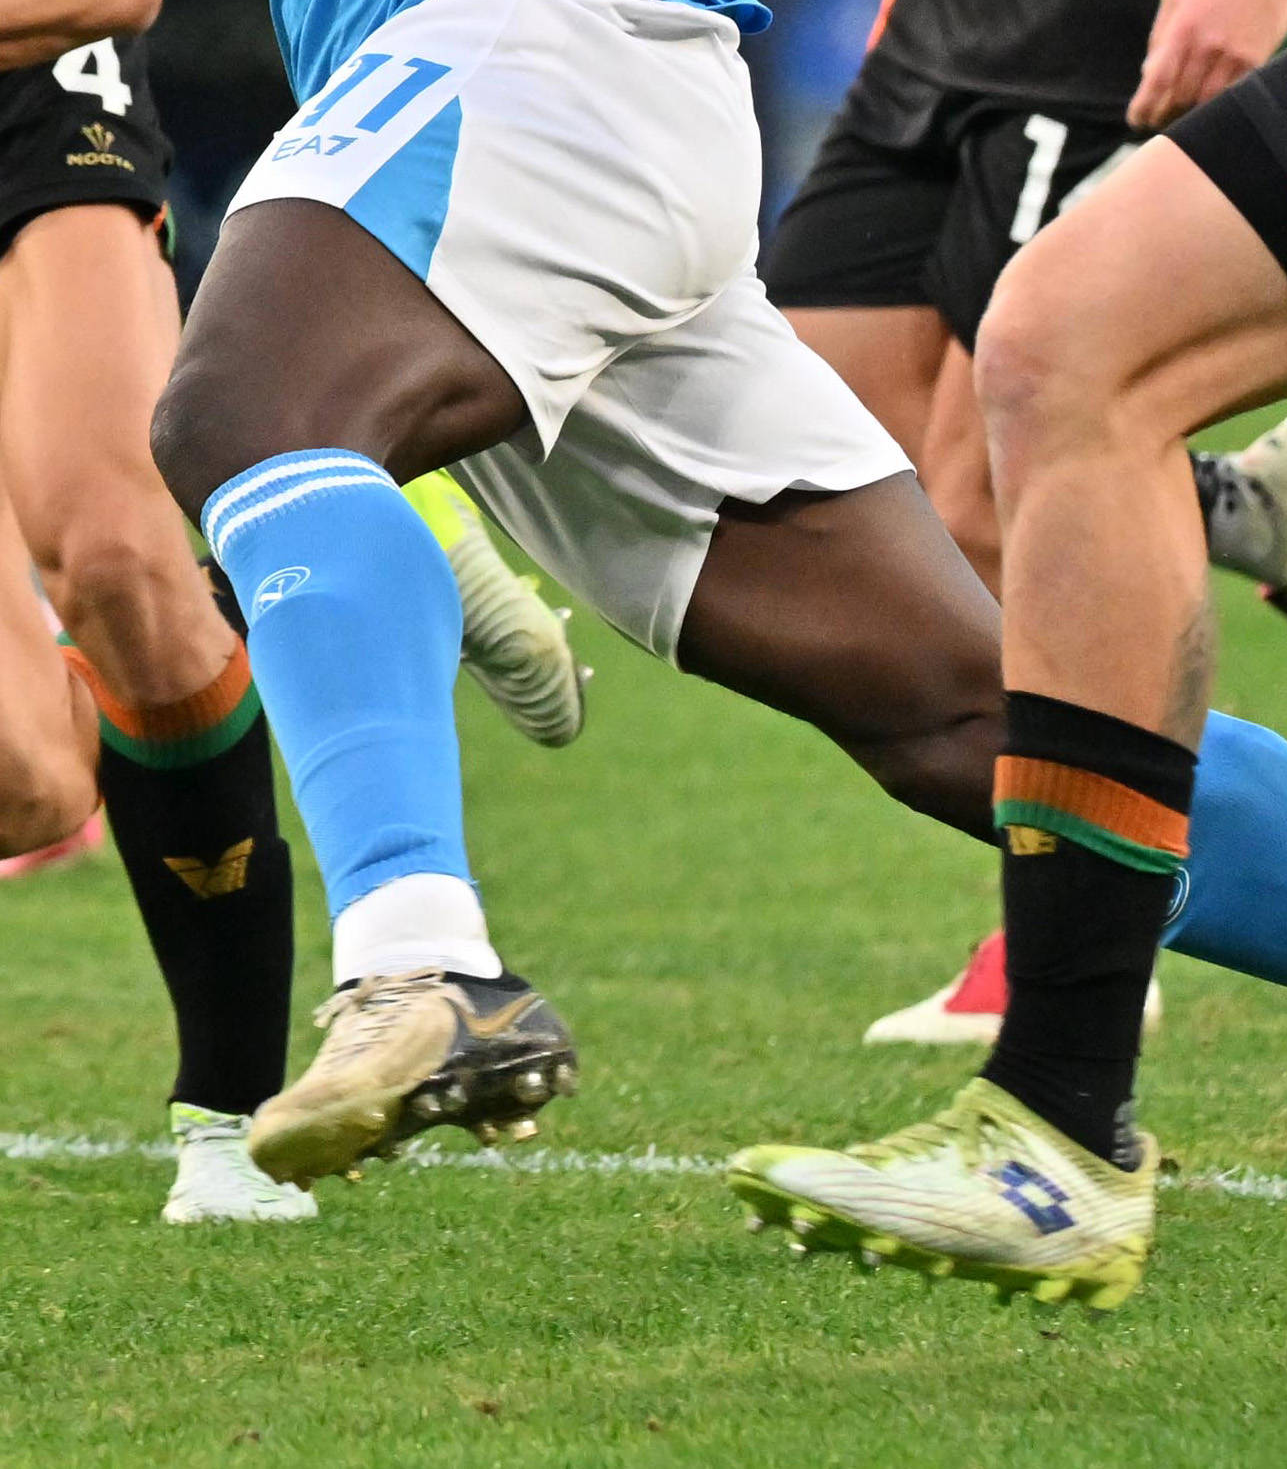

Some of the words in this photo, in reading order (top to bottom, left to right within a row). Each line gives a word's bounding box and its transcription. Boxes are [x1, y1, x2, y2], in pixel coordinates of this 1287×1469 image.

[51, 36, 133, 117] 4
[297, 53, 454, 134] 11
[271, 134, 359, 162] EA7
